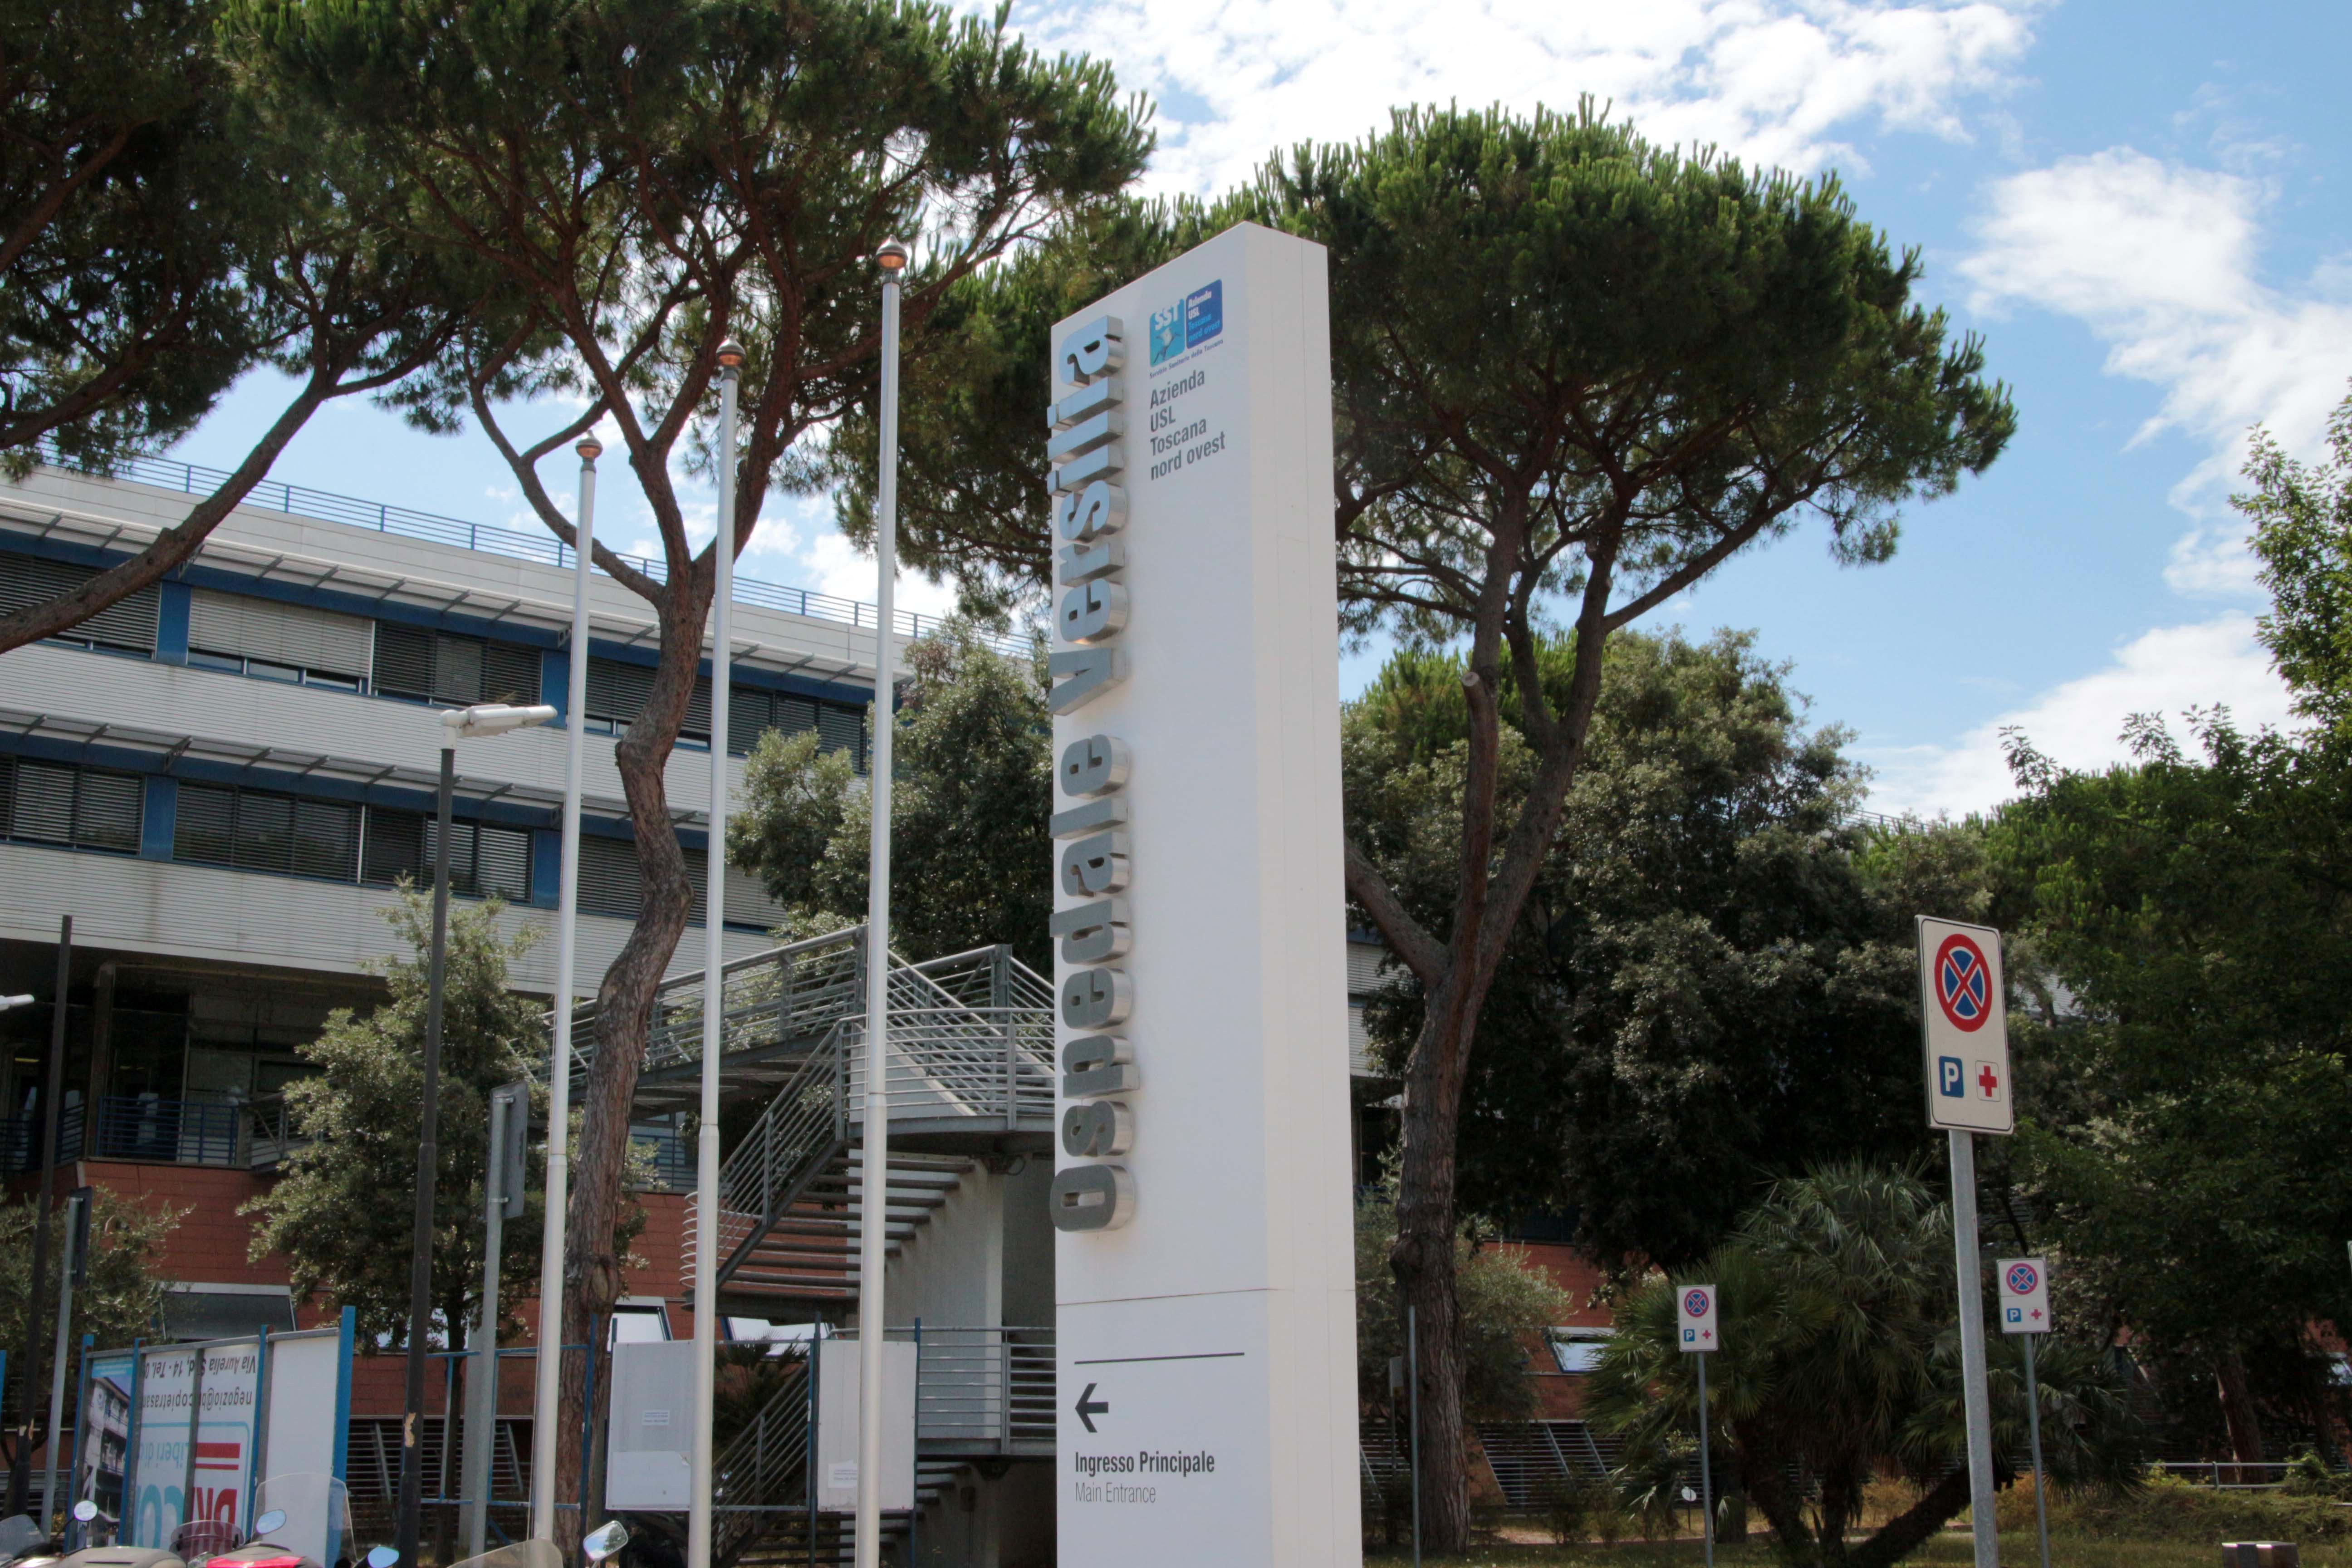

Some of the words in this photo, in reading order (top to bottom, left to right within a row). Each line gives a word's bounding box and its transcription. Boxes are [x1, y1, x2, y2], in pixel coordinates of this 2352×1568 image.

[1155, 301, 1180, 331] SST
[1188, 307, 1200, 319] USL
[1188, 328, 1202, 342] nord
[1204, 320, 1220, 334] ovest
[1191, 349, 1203, 358] della
[1150, 370, 1205, 409] Azienda
[1150, 406, 1176, 432] USL
[1150, 418, 1207, 456] Toscana
[1151, 451, 1182, 480] nord
[1186, 431, 1225, 465] ovest
[1047, 315, 1125, 717] Versilia
[1049, 733, 1133, 1233] Ospedale
[1944, 1062, 1959, 1092] P
[152, 1361, 166, 1378] Tel.
[173, 1361, 183, 1377] 14
[187, 1356, 206, 1377] Sd,
[209, 1357, 240, 1375] Aurelia
[242, 1356, 256, 1373] Via
[155, 1441, 189, 1470] iberi
[1075, 1452, 1134, 1477] Ingresso
[1139, 1451, 1215, 1477] Principale
[1075, 1482, 1102, 1502] Main
[1106, 1482, 1156, 1503] Entrance
